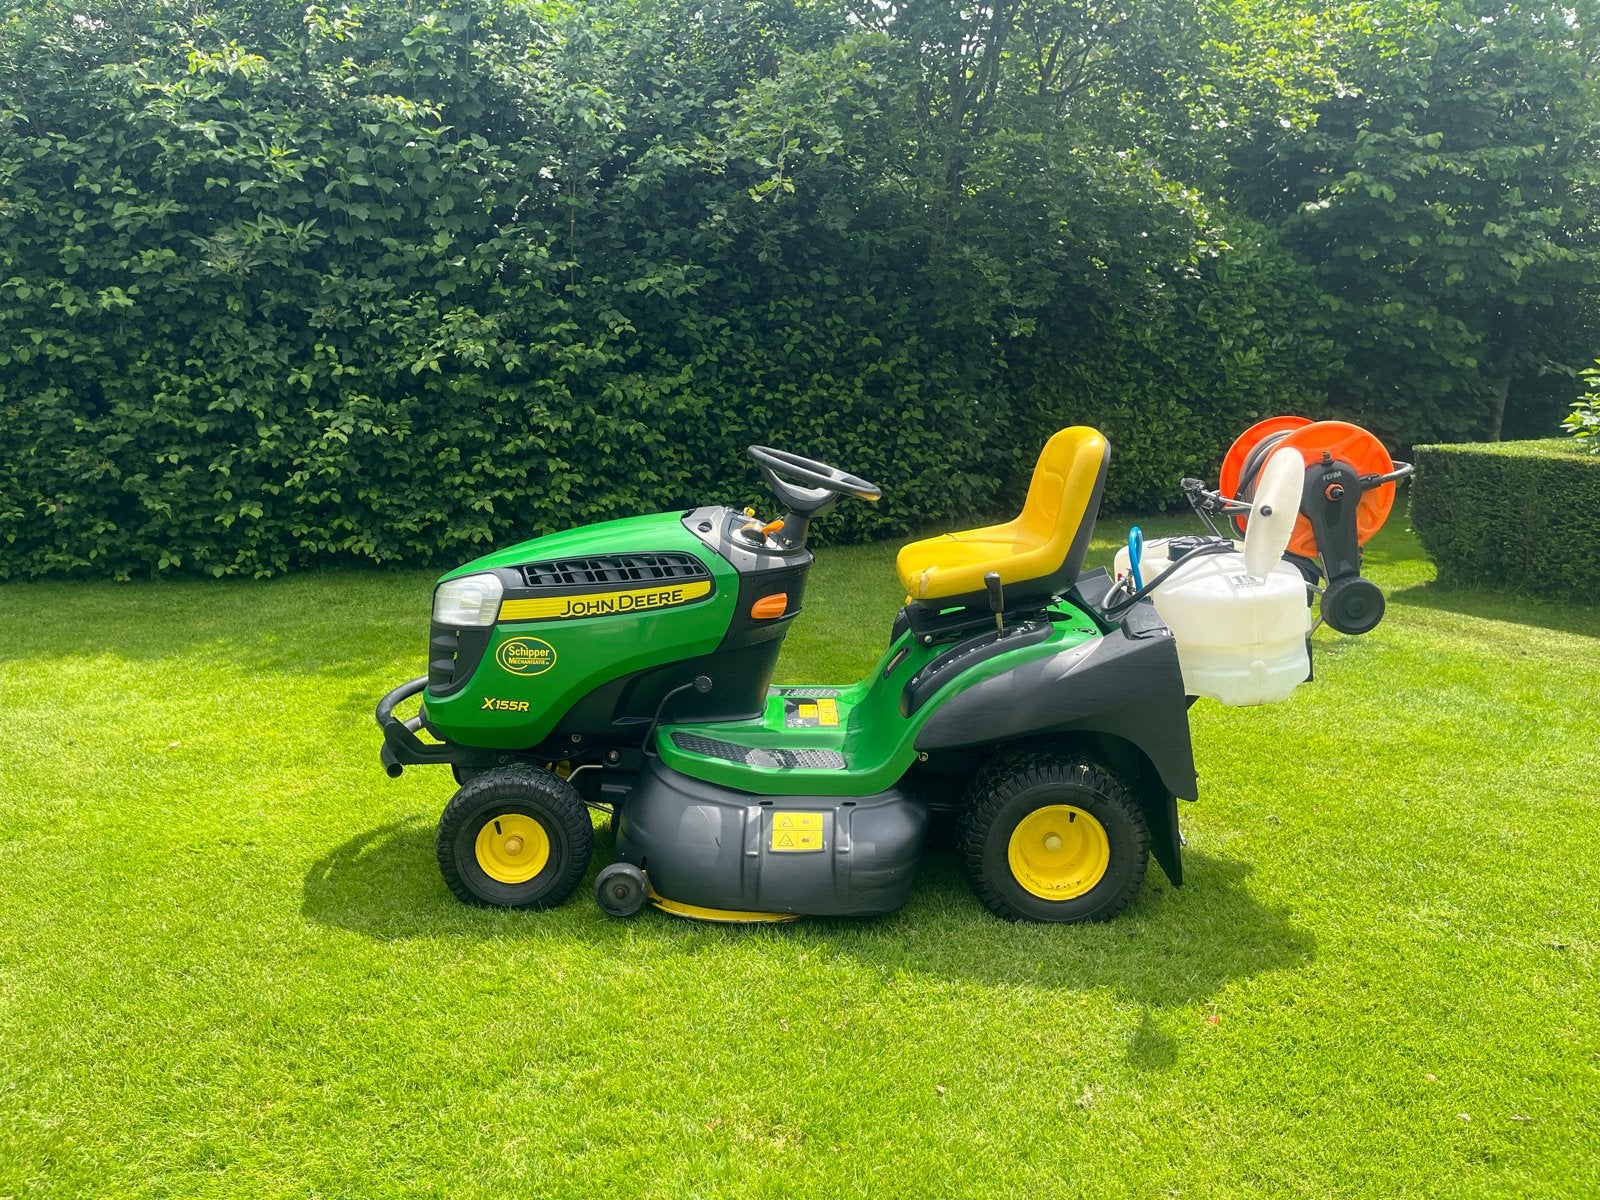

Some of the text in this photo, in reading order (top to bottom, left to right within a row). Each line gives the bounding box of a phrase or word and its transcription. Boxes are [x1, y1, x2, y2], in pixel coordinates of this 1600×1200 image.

[1322, 470, 1342, 481] FERM
[560, 589, 683, 616] JOHN DEERE
[508, 645, 550, 658] Schipper
[480, 697, 530, 712] X155R
